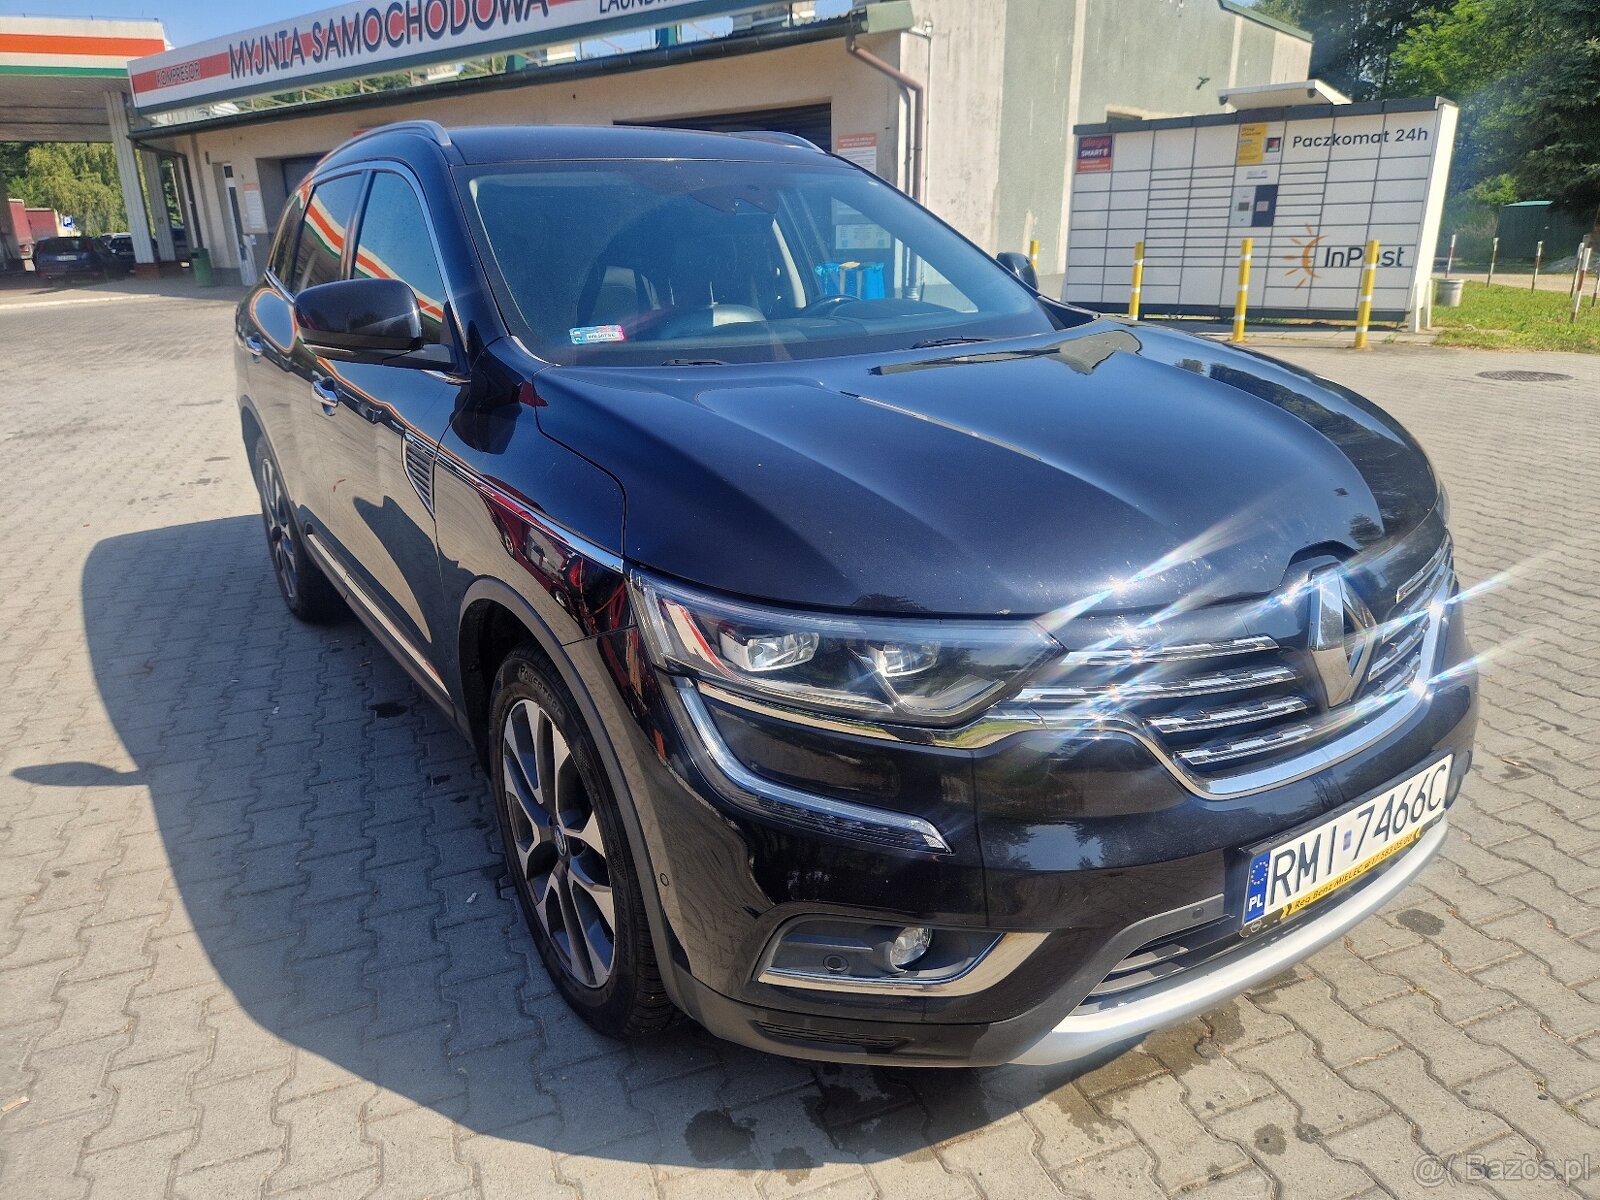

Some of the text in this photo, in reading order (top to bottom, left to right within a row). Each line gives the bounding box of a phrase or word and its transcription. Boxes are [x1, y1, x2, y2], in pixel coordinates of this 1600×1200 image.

[229, 27, 305, 80] MYJNIA
[156, 61, 201, 88] KOMPRESOR
[1292, 127, 1428, 148] Paczkomat 24h
[1324, 247, 1405, 267] InPst
[1270, 764, 1447, 905] RMI 7466C
[1334, 863, 1364, 887] MIELEC
[1248, 897, 1264, 912] PL
